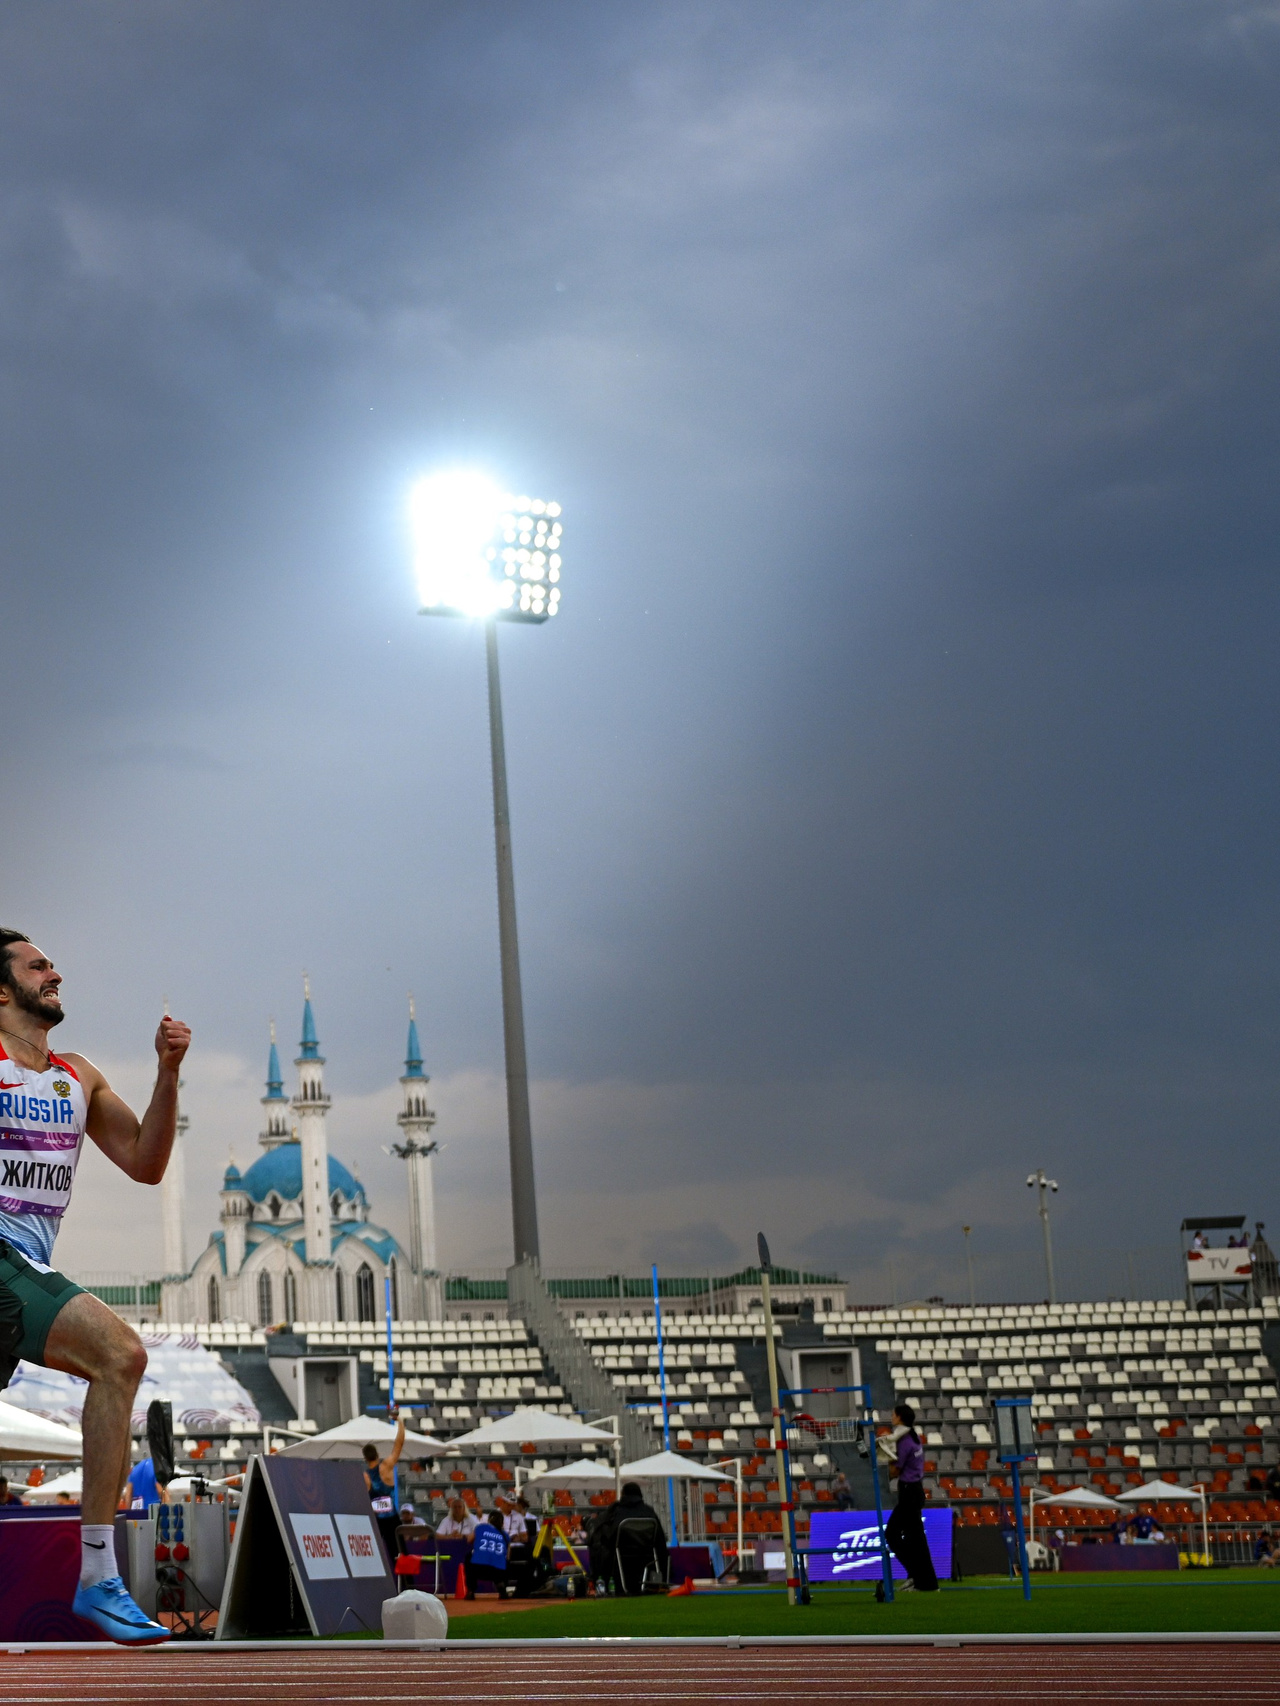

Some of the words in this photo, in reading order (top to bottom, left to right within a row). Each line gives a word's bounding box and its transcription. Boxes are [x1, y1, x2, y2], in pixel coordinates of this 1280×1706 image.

[1, 1159, 72, 1191] ЖИТКОВ
[1208, 1257, 1229, 1270] TV
[303, 1535, 334, 1558] FONBET
[348, 1535, 374, 1557] FONBET
[479, 1539, 504, 1555] 233
